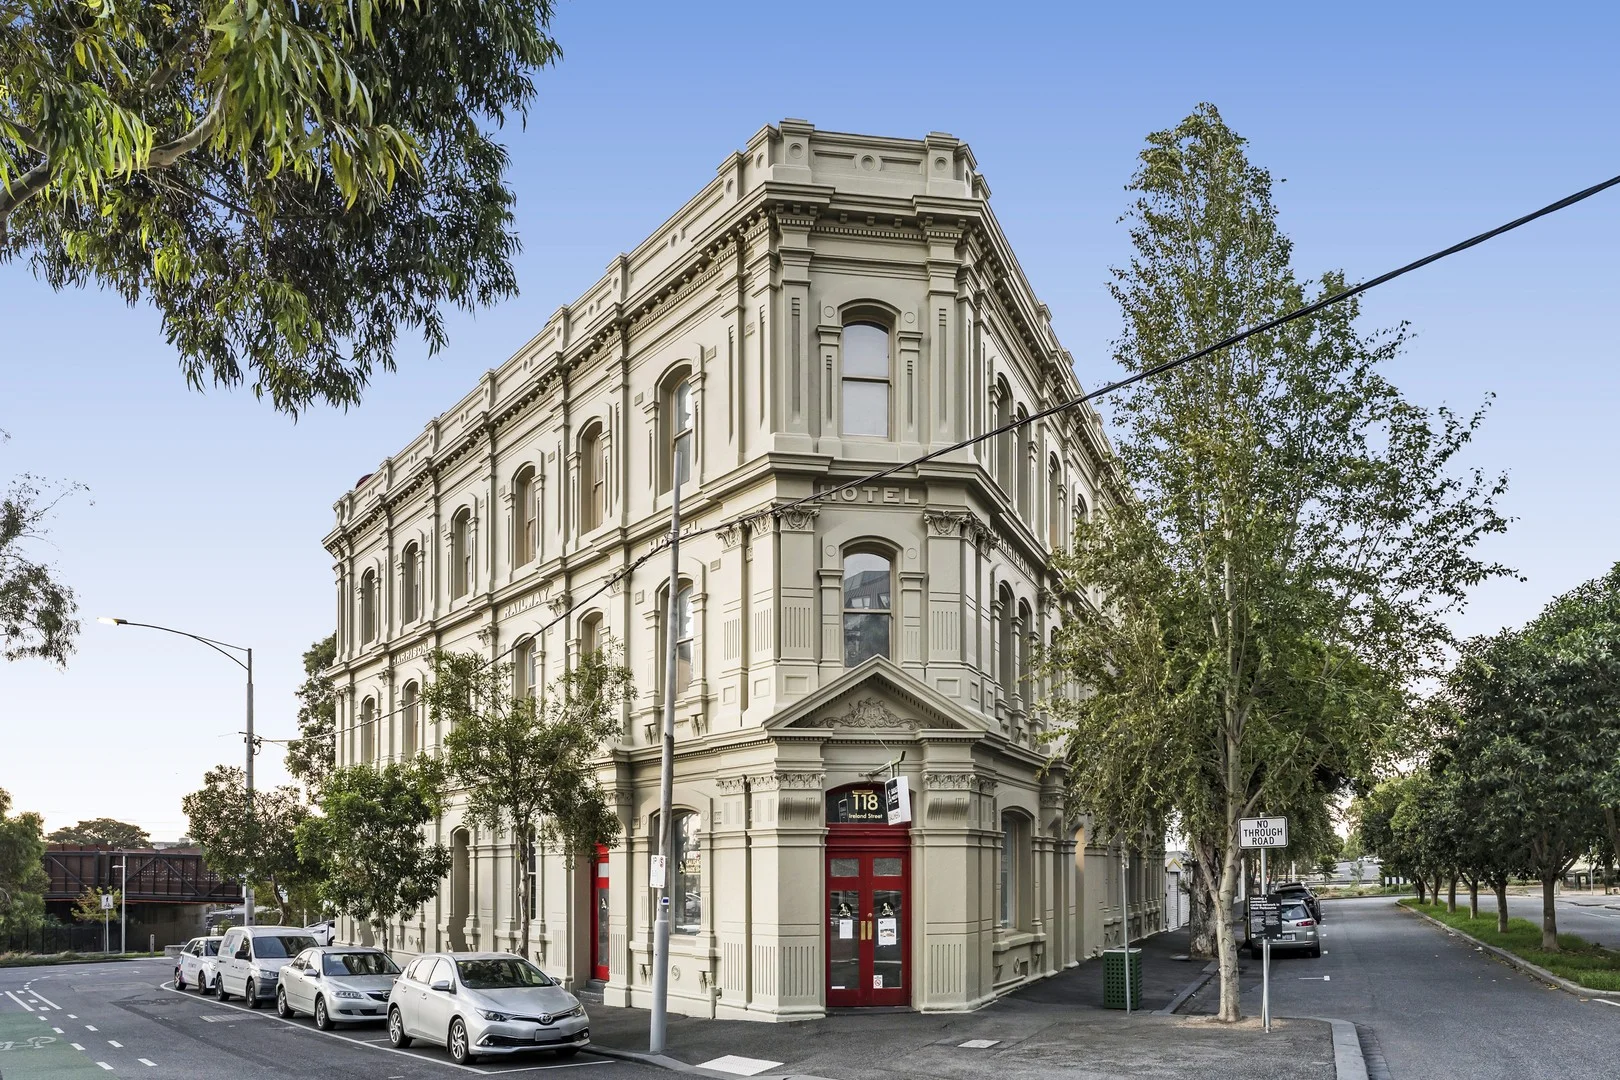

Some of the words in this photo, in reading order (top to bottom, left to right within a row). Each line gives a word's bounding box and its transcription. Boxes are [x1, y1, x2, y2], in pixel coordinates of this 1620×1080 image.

[820, 484, 919, 504] HOTEL
[504, 588, 550, 618] RAILWAY
[852, 794, 878, 811] 118
[1256, 820, 1269, 829] NO
[1243, 828, 1283, 837] THROUGH
[1252, 836, 1275, 846] ROAD
